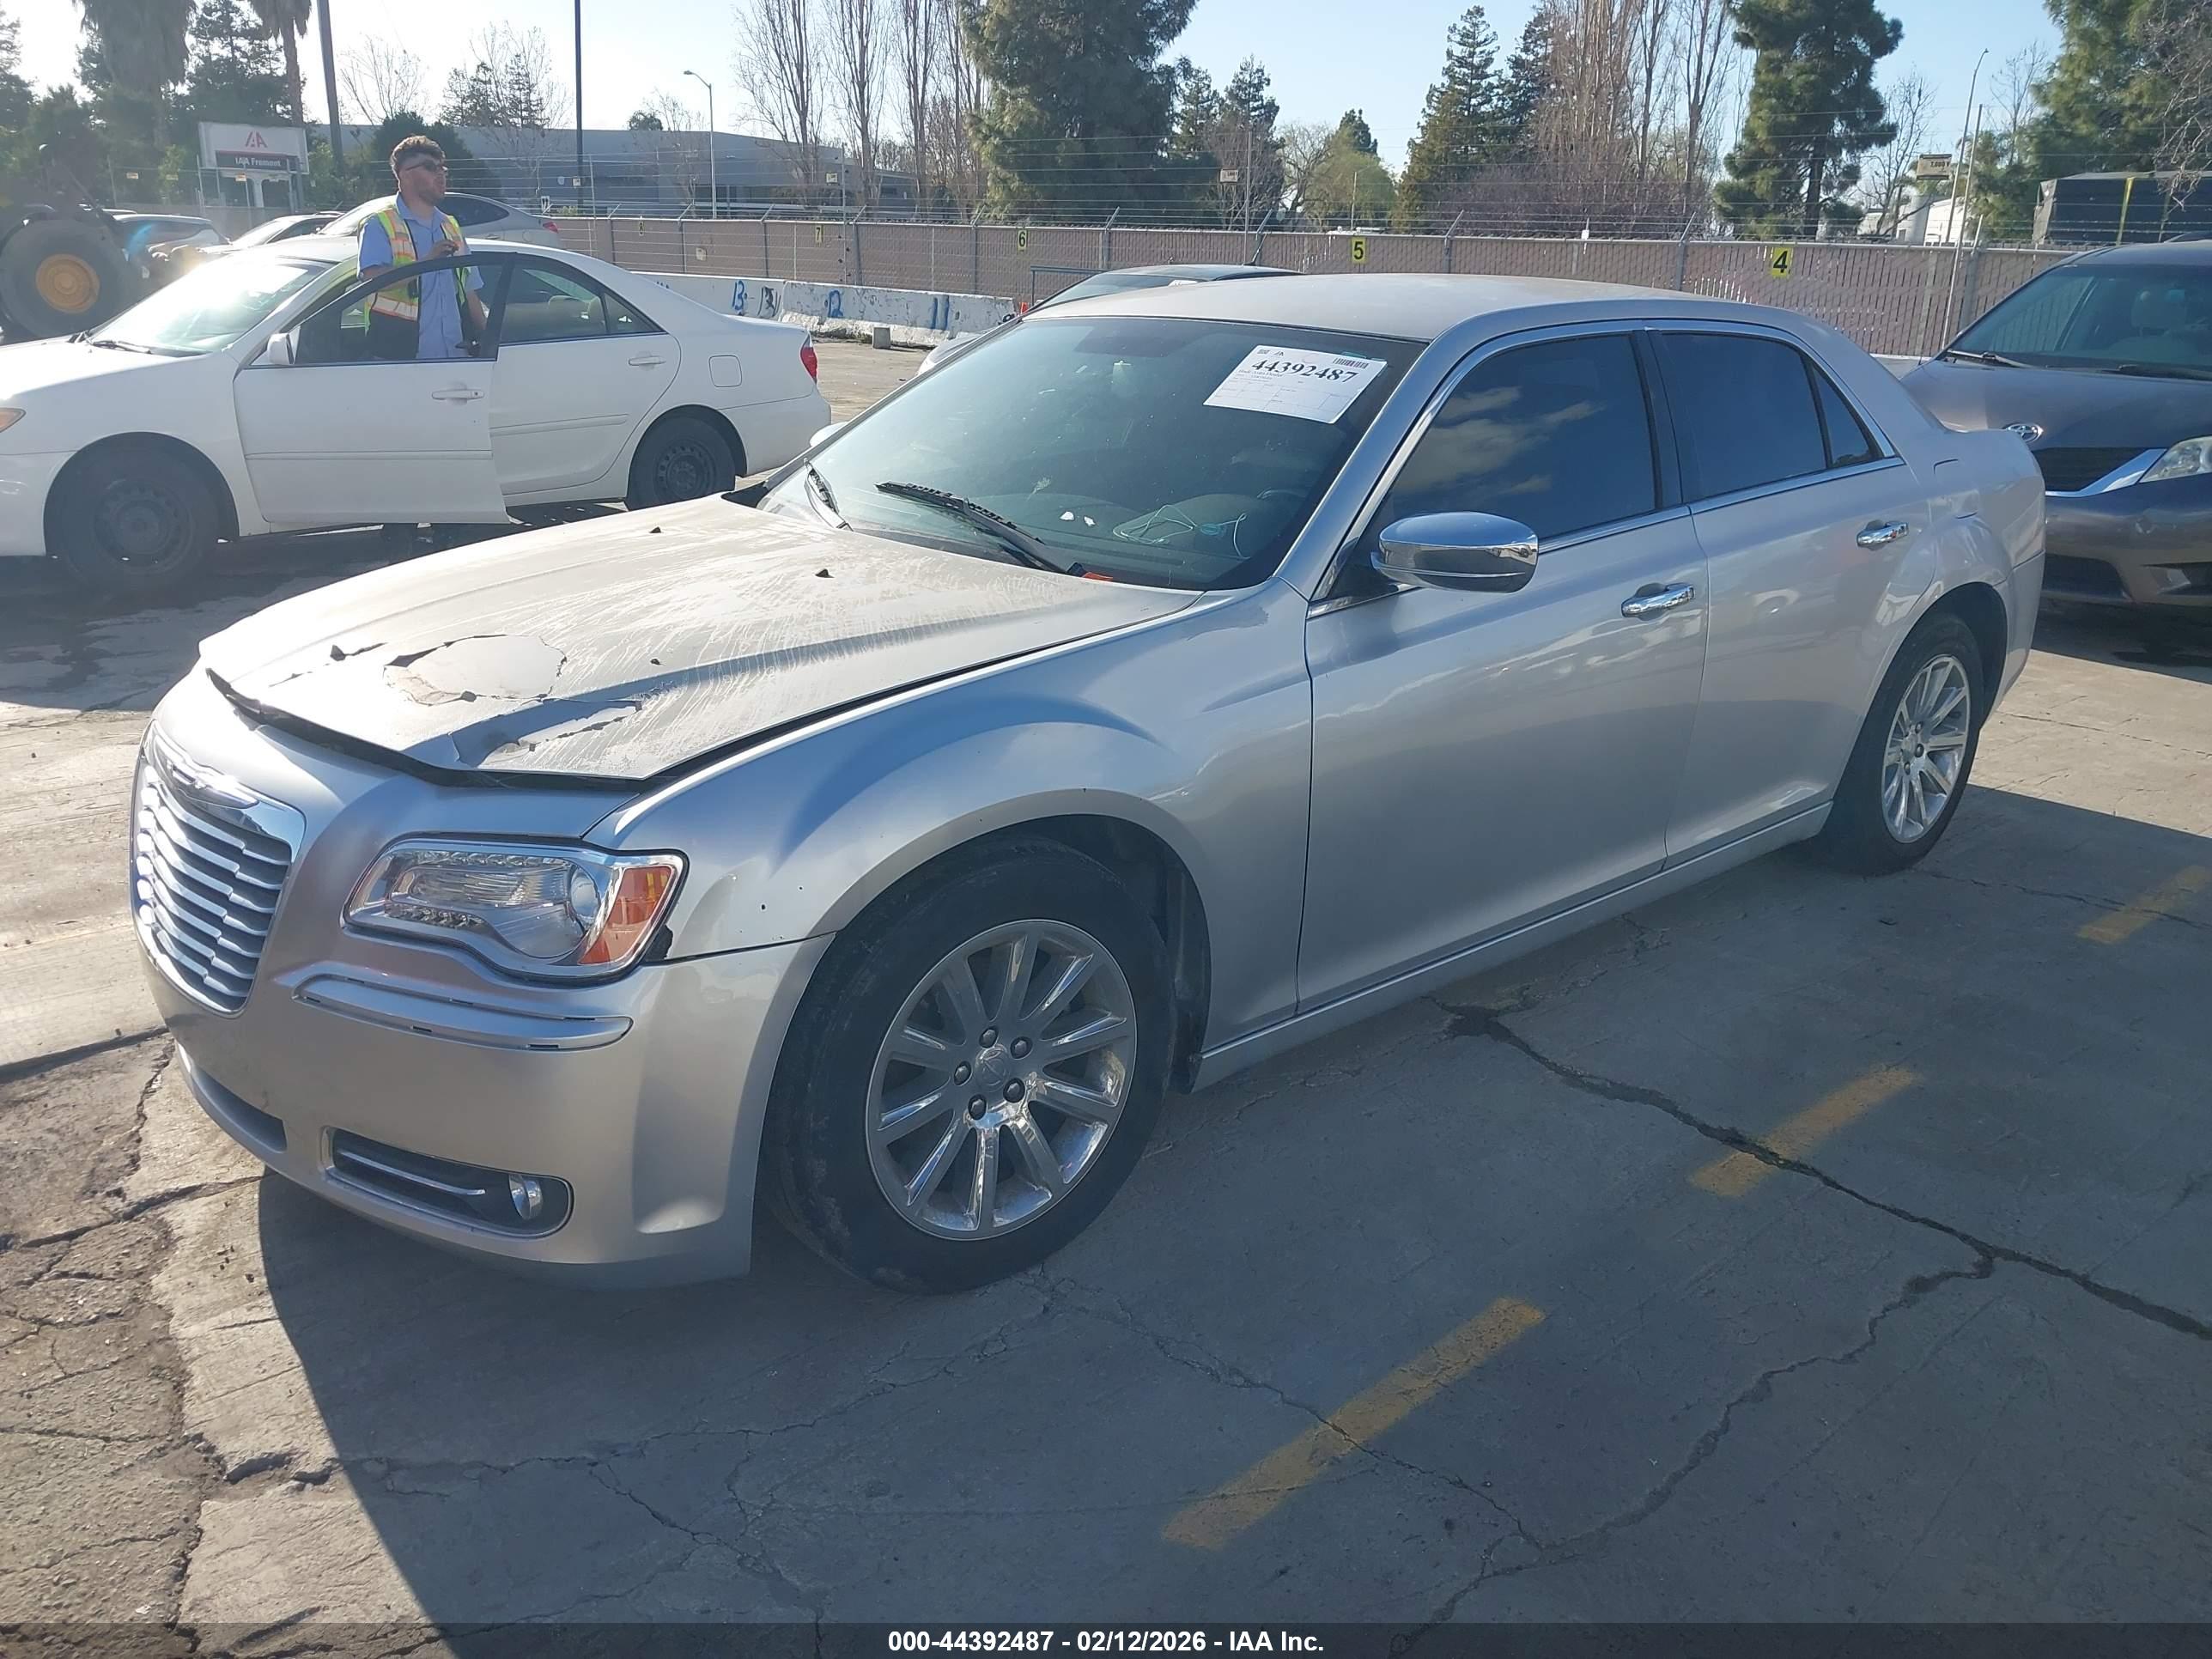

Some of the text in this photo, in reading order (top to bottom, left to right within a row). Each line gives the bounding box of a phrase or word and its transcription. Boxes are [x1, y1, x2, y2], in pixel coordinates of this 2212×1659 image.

[251, 157, 282, 167] Fremont
[816, 227, 821, 241] 7
[1018, 231, 1026, 247] 6
[1354, 240, 1364, 260] 5
[1773, 250, 1788, 273] 4
[1251, 359, 1359, 383] 44392487
